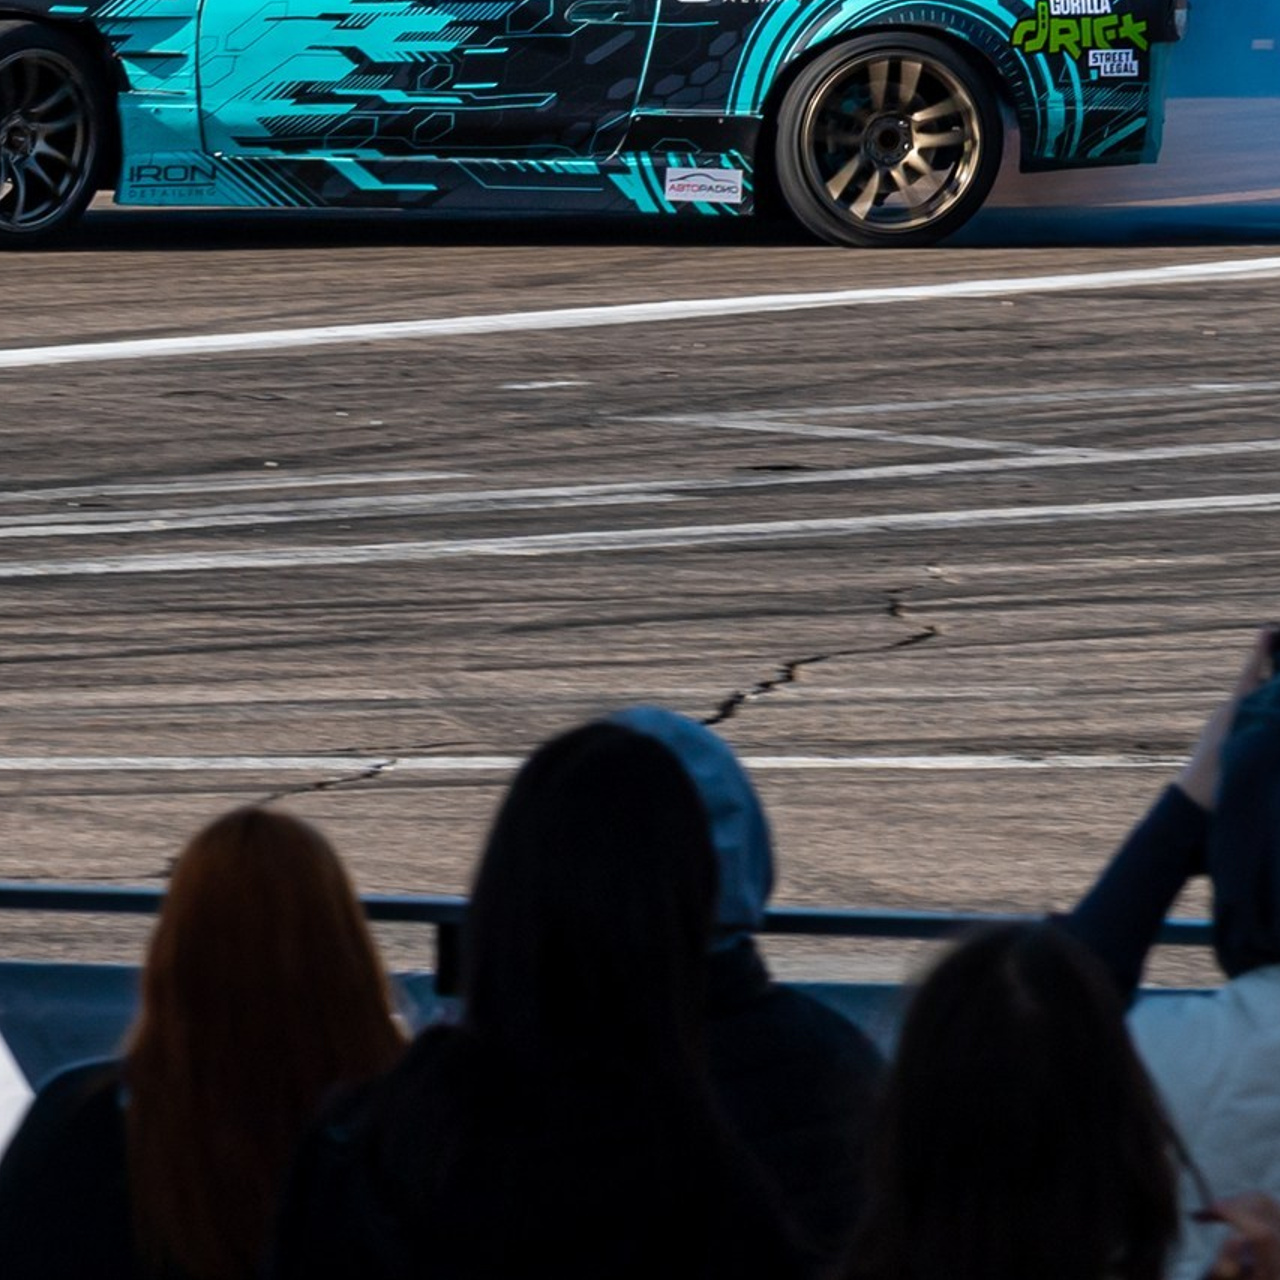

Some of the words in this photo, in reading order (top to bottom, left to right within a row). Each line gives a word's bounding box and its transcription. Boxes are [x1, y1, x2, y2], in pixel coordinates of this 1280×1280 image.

[1091, 51, 1131, 63] STREET
[1103, 62, 1136, 74] LEGAL
[130, 165, 216, 181] IRON
[129, 187, 216, 198] DETAILING
